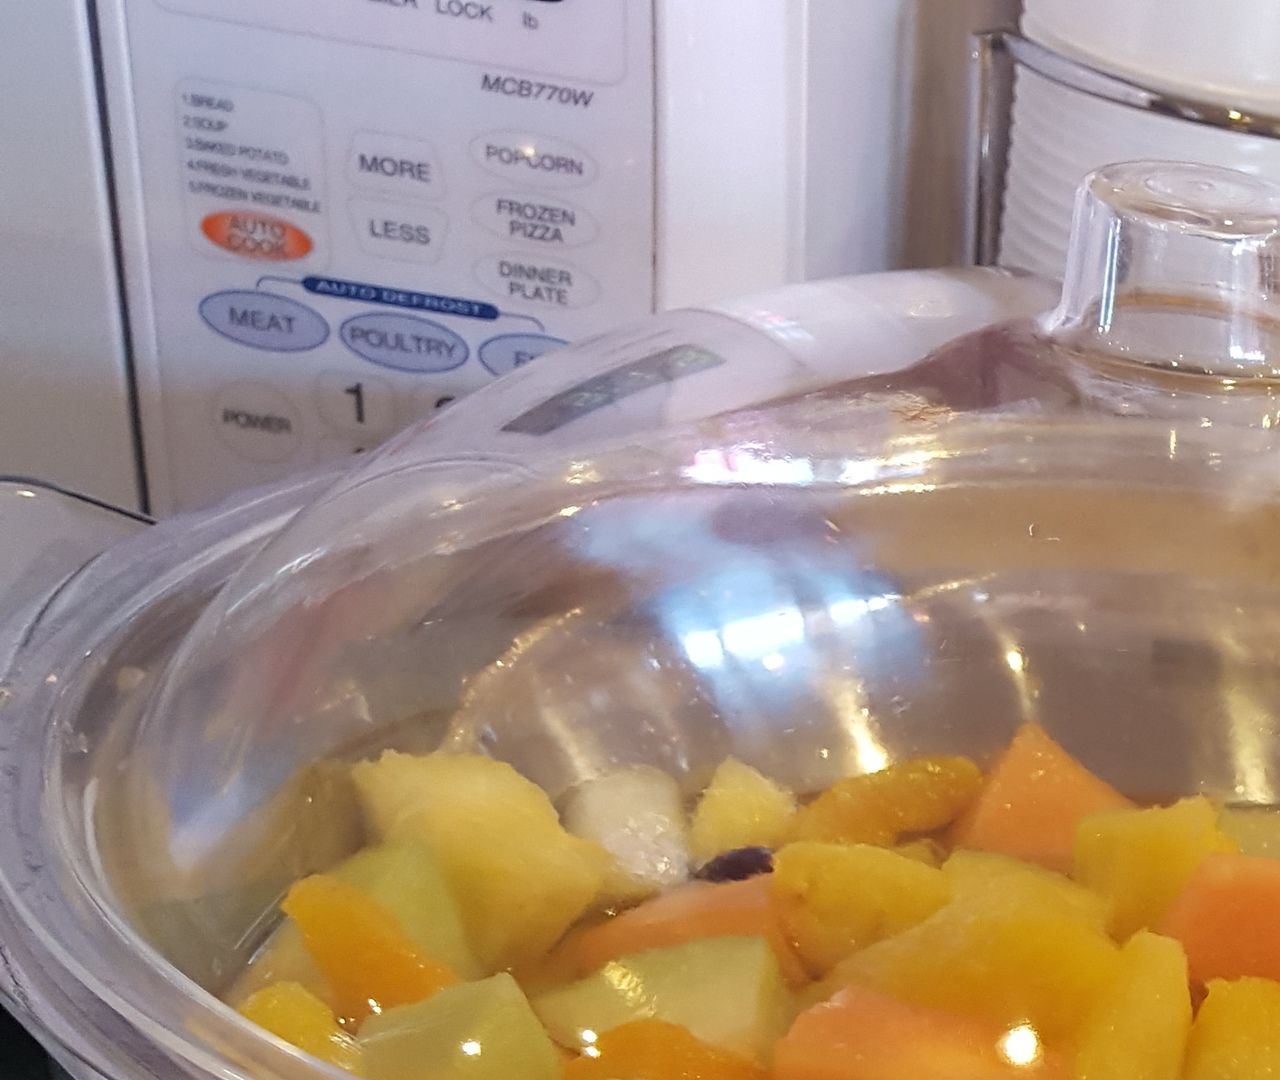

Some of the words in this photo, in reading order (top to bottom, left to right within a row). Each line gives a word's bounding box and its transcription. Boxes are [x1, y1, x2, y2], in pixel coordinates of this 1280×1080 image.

[435, 0, 494, 22] LOCK
[481, 74, 594, 107] MCB770W
[358, 154, 431, 182] MORE
[486, 144, 583, 176] POPCORN
[496, 198, 576, 226] FROZEN
[228, 215, 287, 241] AUTO
[369, 218, 431, 245] LESS
[510, 219, 564, 243] PIZZA
[499, 260, 572, 286] DINNER
[315, 279, 376, 301] AUTO
[380, 289, 483, 317] DEFROST
[510, 281, 569, 306] PLATE
[229, 307, 297, 334] MEAT
[350, 325, 458, 359] POULTRY
[345, 382, 365, 424] 1
[222, 407, 293, 434] POWER
